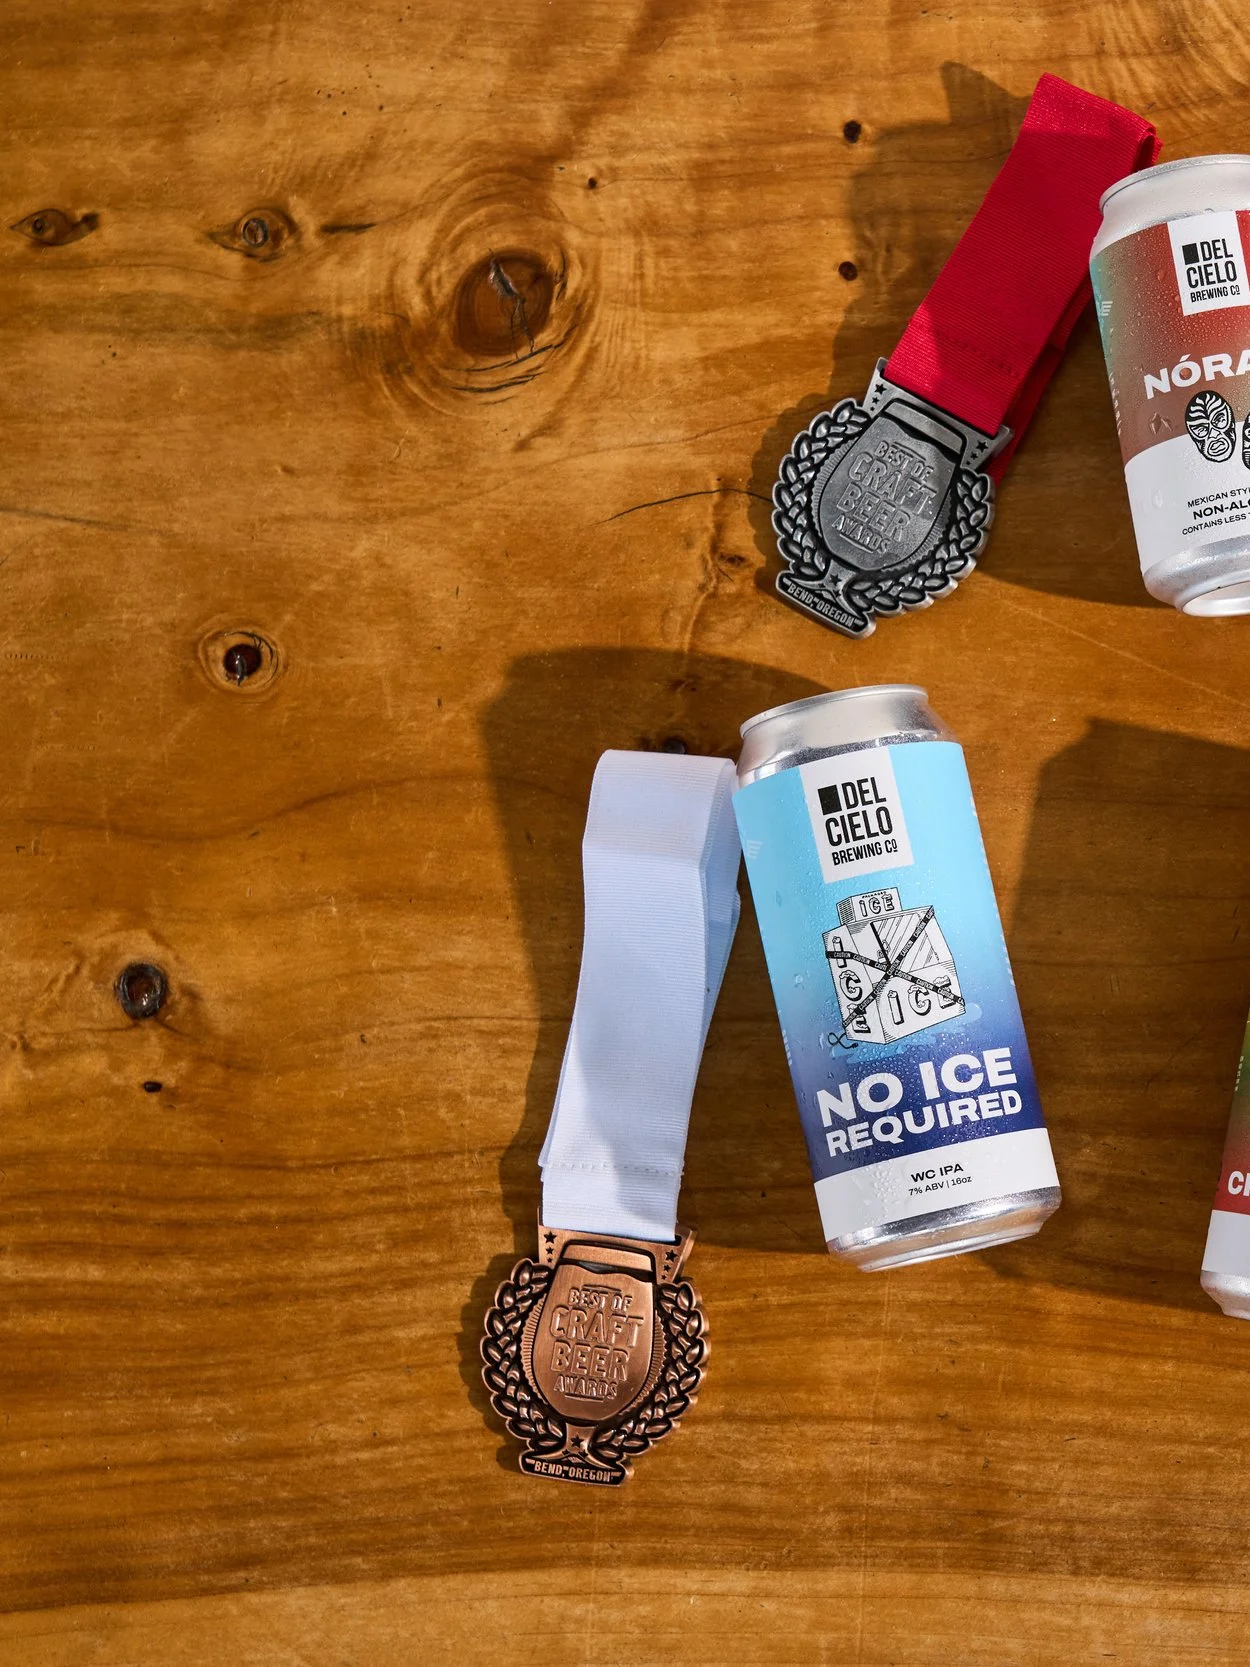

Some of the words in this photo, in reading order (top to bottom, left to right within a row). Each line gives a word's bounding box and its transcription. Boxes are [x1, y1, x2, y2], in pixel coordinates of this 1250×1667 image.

[1200, 238, 1233, 261] DEL
[1186, 260, 1237, 288] CIELO
[1190, 286, 1229, 303] BREWING
[875, 441, 914, 469] BEST
[911, 461, 934, 483] OF
[849, 452, 937, 516] CRAFT
[836, 482, 911, 541] BEER
[1187, 491, 1229, 508] MEXICAN
[832, 513, 891, 553] AWARDS
[1182, 518, 1223, 535] CONTAINS
[1224, 513, 1247, 524] LESS
[816, 597, 855, 627] OREGON
[841, 777, 887, 810] DEL
[825, 806, 893, 847] CIELO
[832, 841, 882, 866] BREWING
[859, 894, 895, 917] ICE
[816, 1072, 903, 1128] NO
[919, 1047, 1018, 1101] ICE
[826, 1089, 1023, 1158] REQUIRED
[908, 1186, 923, 1196] 7%
[925, 1181, 945, 1192] ABV
[951, 1176, 972, 1186] 16oz
[910, 1169, 936, 1183] WC
[940, 1163, 964, 1176] IPA
[569, 1287, 608, 1309] BEST
[612, 1293, 632, 1311] OF
[550, 1304, 644, 1348] CRAFT
[550, 1338, 629, 1382] BEER
[553, 1374, 617, 1400] AWARDS
[568, 1466, 611, 1482] OREGON
